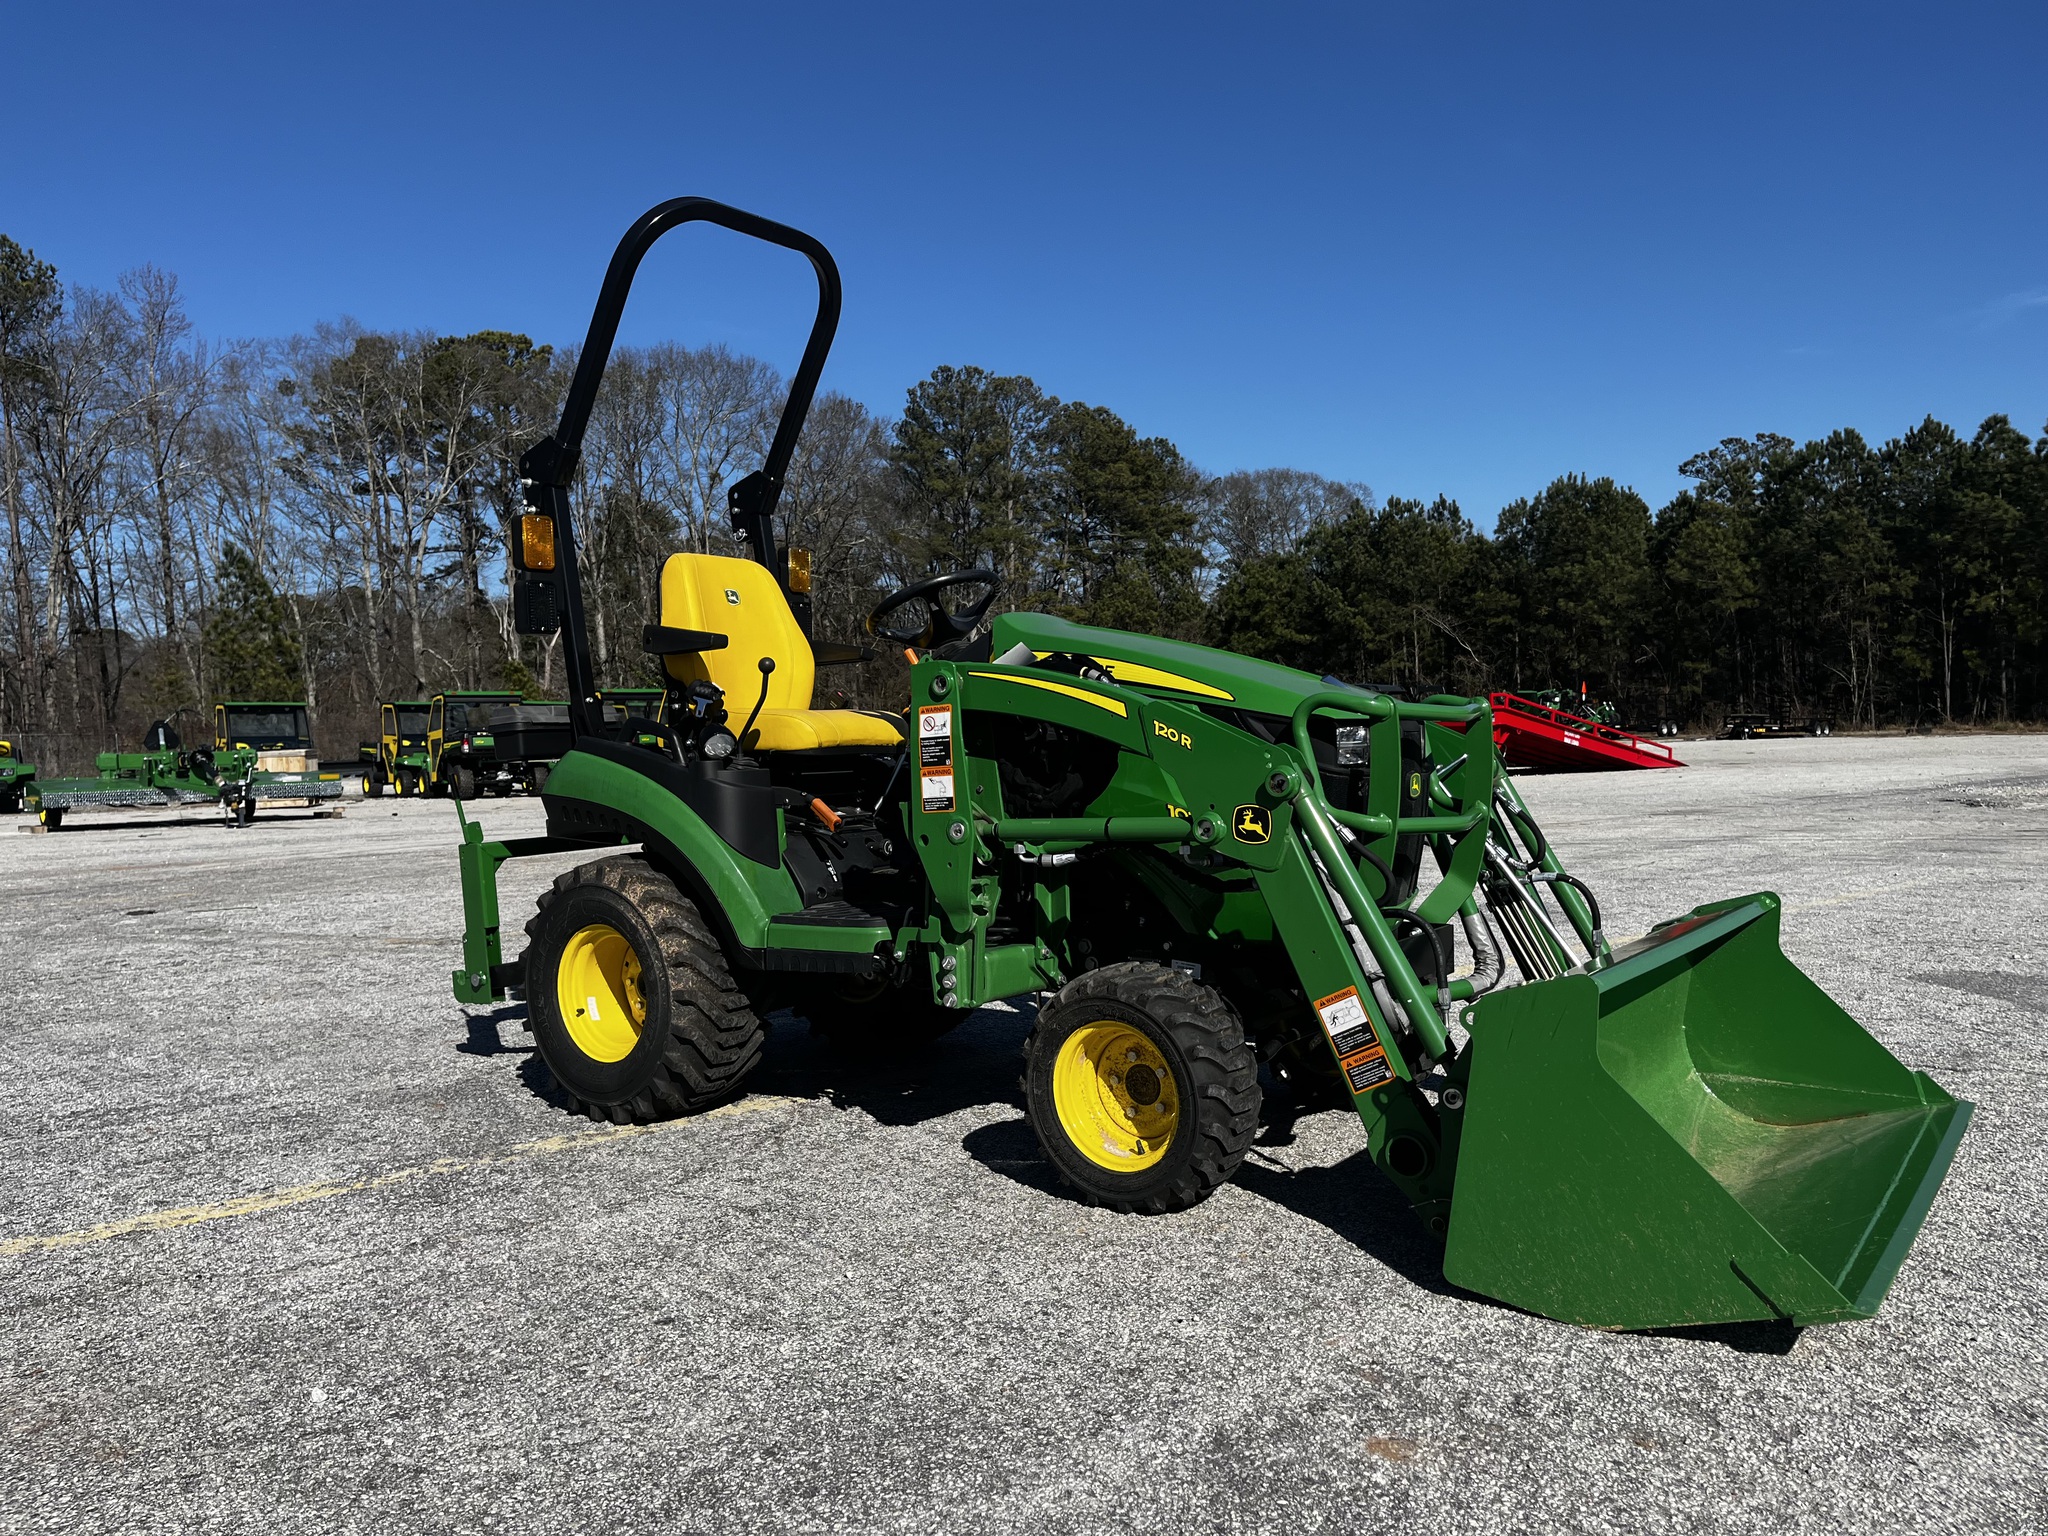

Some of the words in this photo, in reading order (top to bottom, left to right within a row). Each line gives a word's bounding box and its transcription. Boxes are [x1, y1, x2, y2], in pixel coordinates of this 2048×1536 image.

[925, 705, 950, 713] WARNING
[1153, 719, 1179, 742] 120
[1180, 733, 1192, 750] R
[927, 768, 951, 776] WARNING
[1167, 803, 1192, 818] 10
[1326, 990, 1351, 1004] WARNING
[1353, 1050, 1379, 1064] WARNING
